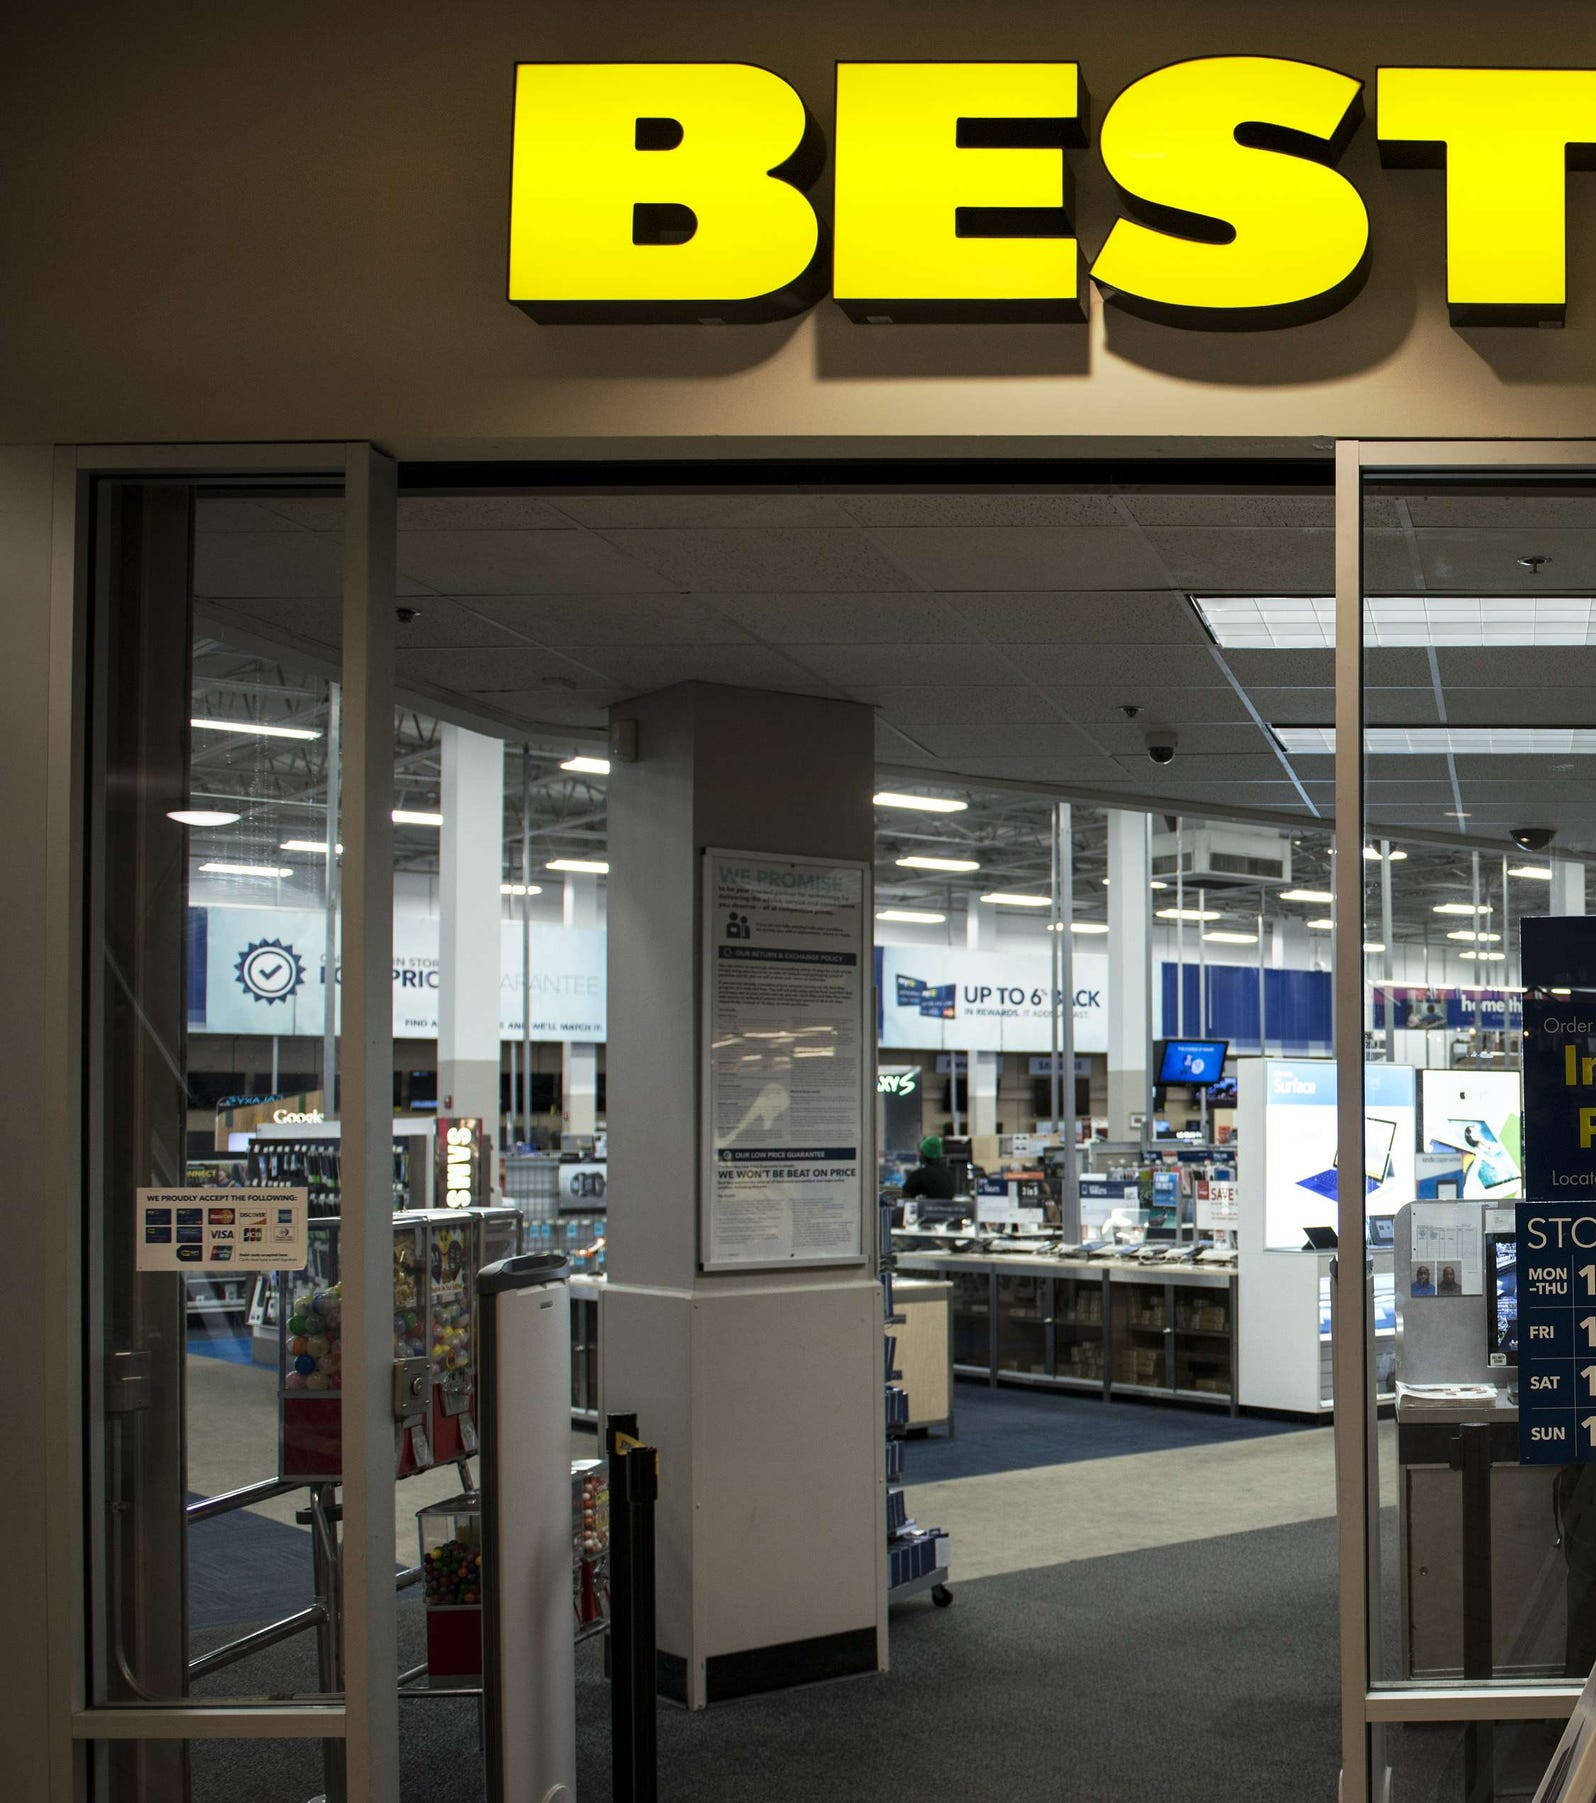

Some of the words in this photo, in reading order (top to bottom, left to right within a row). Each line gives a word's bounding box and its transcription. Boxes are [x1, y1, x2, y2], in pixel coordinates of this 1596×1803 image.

[964, 986, 992, 1004] UP
[997, 987, 1025, 1005] TO
[1543, 1017, 1594, 1035] Order
[1273, 1079, 1317, 1095] Surface
[718, 1170, 734, 1179] WE
[736, 1169, 770, 1178] WON'T
[772, 1169, 785, 1178] BE
[786, 1169, 810, 1178] BEAT
[813, 1169, 828, 1177] ON
[830, 1168, 857, 1177] PRICE
[161, 1194, 198, 1202] PROUDLY
[248, 1194, 298, 1202] FOLLOWING:
[210, 1230, 234, 1239] VISA
[1528, 1267, 1568, 1280] MON
[1529, 1325, 1555, 1339] FRI
[1530, 1375, 1560, 1390] SAT
[1530, 1426, 1566, 1441] SUN
